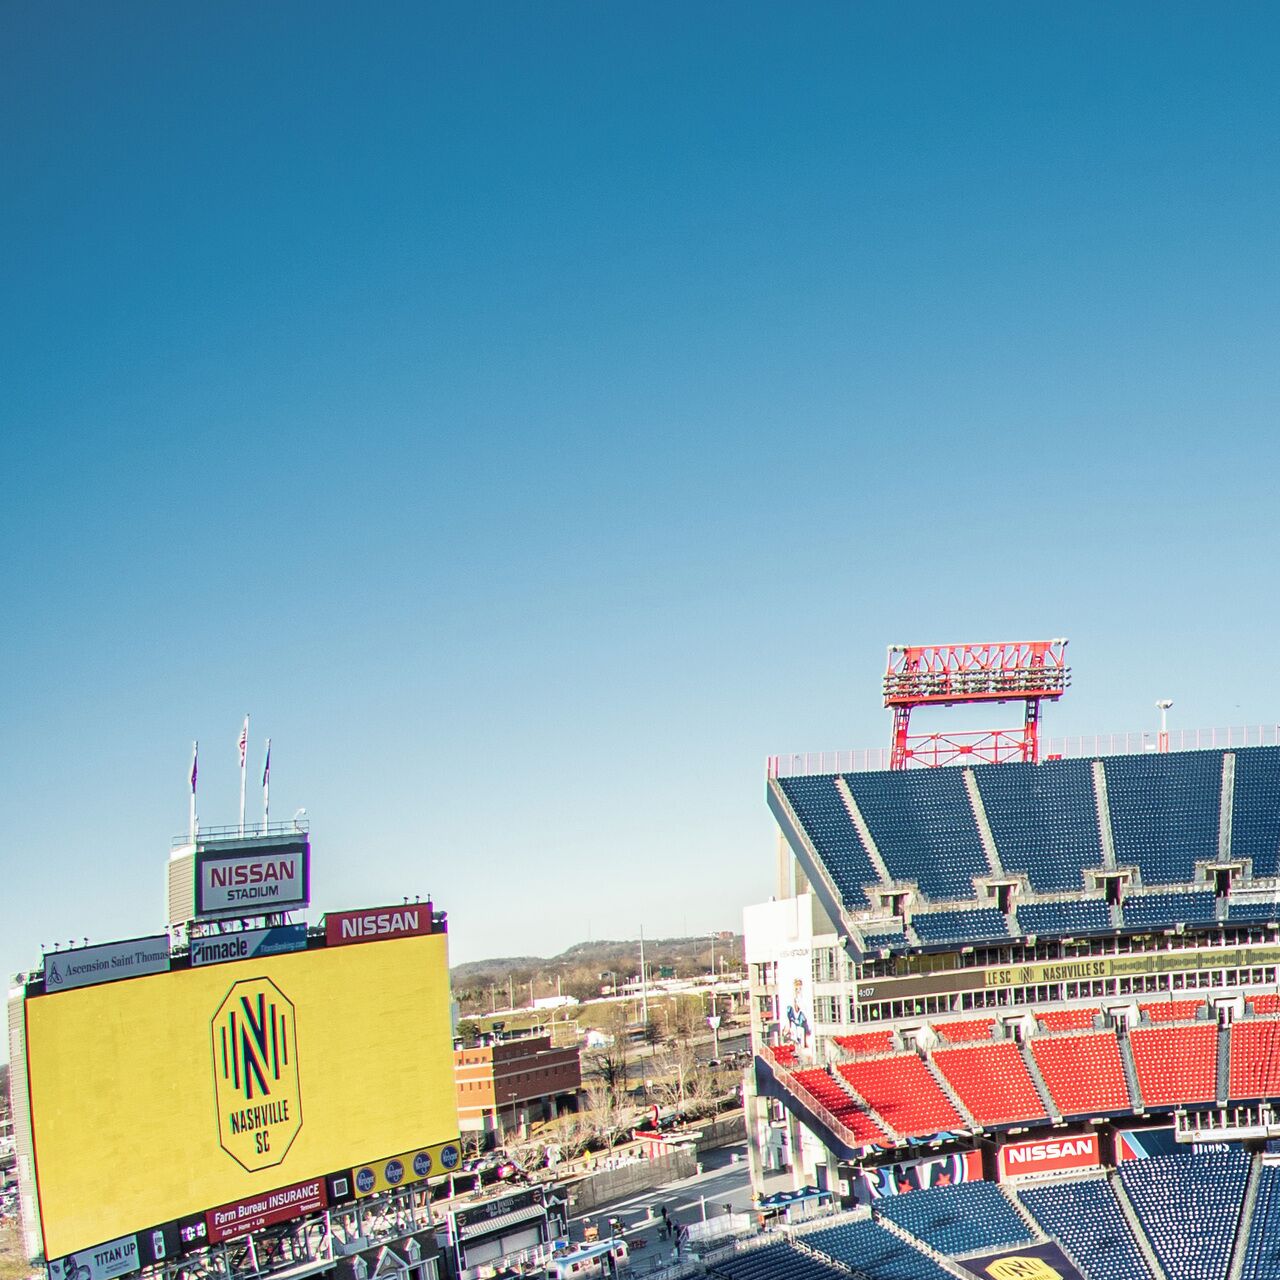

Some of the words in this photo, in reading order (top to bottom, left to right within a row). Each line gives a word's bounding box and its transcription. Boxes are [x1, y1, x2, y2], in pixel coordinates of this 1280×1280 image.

[211, 860, 294, 888] NISSAN
[227, 885, 279, 901] STADIUM
[342, 911, 419, 938] NISSAN
[65, 958, 110, 976] Ascension
[111, 954, 134, 969] Saint
[135, 950, 169, 966] Thomas
[193, 938, 247, 963] Pinnacle
[999, 970, 1011, 984] SC
[1043, 963, 1091, 981] NASHVILLE
[1093, 961, 1105, 976] SC
[230, 1099, 289, 1135] NASHVILLE
[255, 1130, 270, 1154] SC
[1008, 1140, 1093, 1164] NISSAN
[215, 1210, 236, 1225] Farm
[238, 1200, 267, 1217] Bureau
[269, 1183, 320, 1208] INSURANCE
[94, 1248, 122, 1267] TITAN
[123, 1242, 137, 1258] UP
